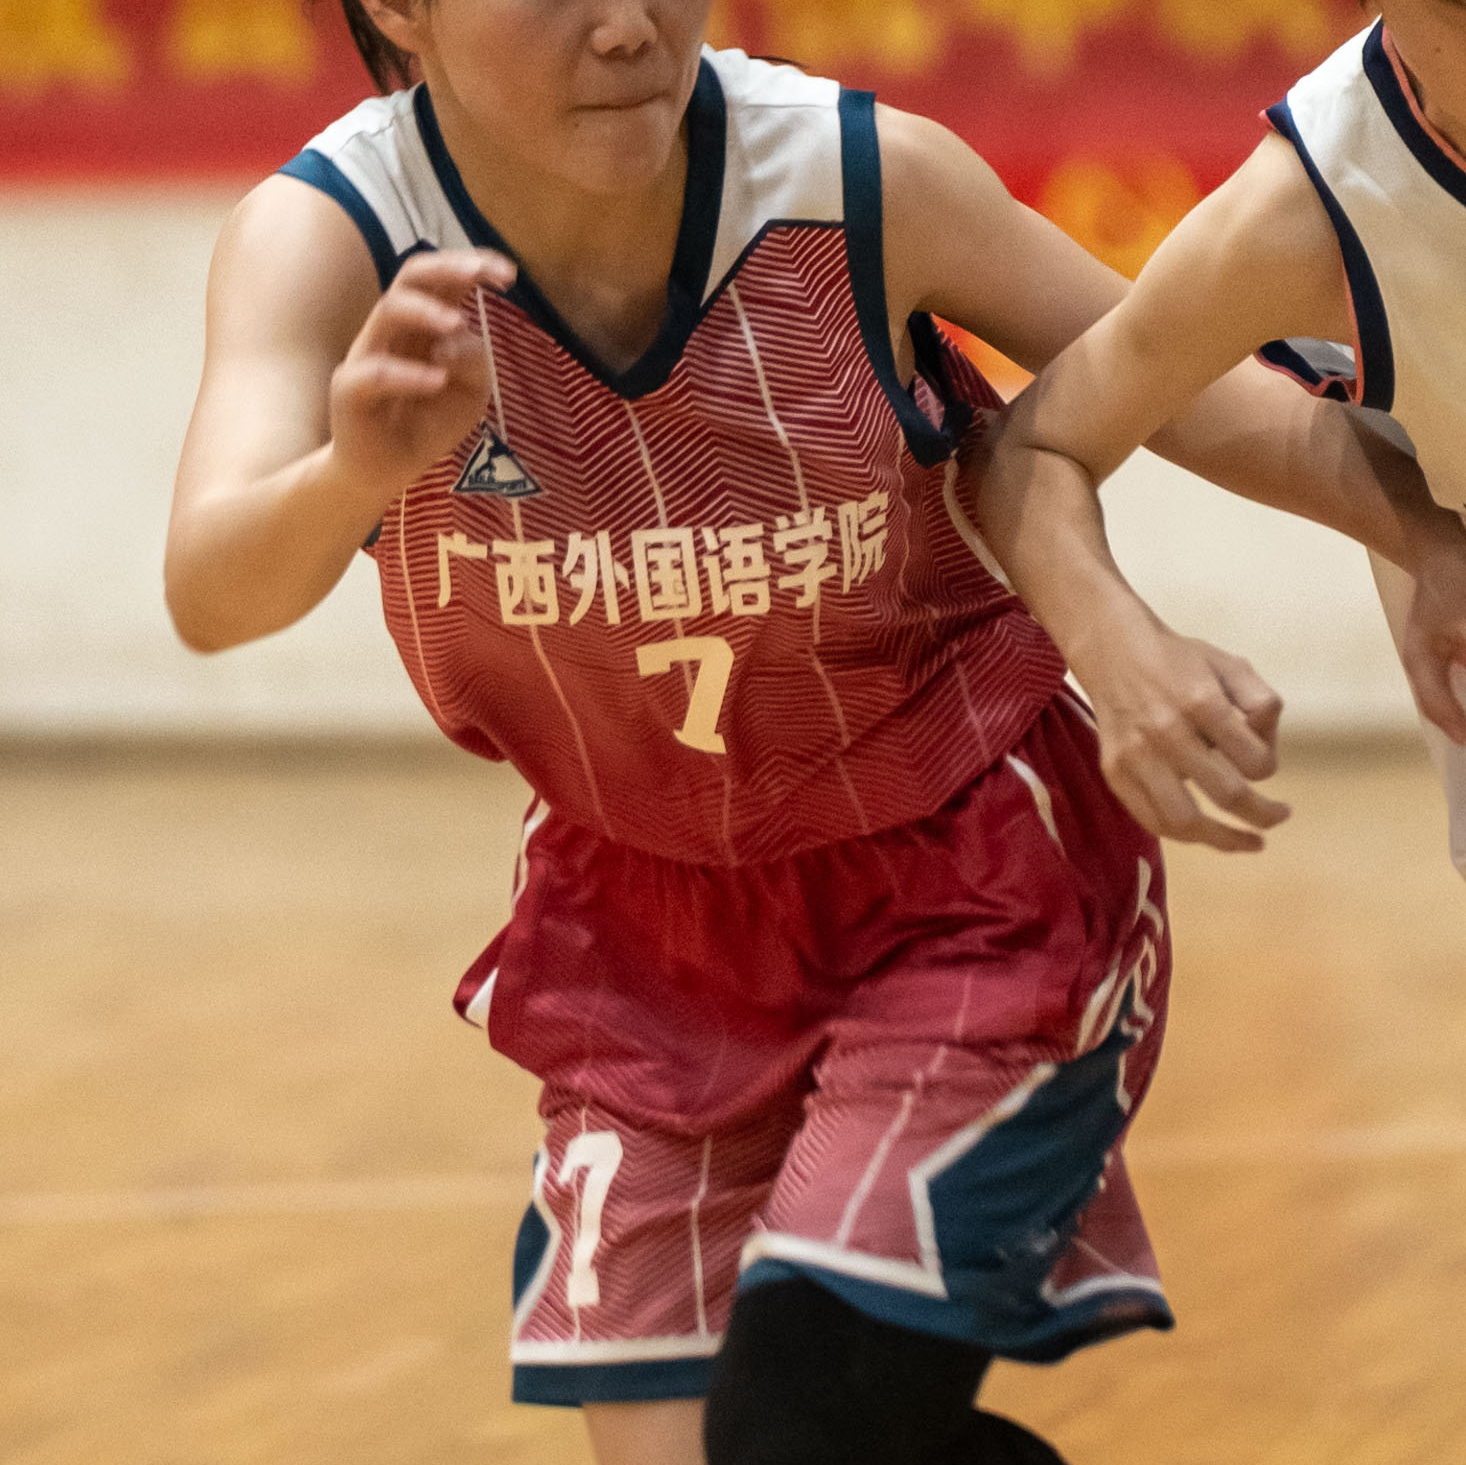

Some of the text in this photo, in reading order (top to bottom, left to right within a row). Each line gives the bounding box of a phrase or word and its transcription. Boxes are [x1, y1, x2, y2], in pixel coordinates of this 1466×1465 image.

[437, 491, 890, 627] 广西外国语学院
[635, 635, 735, 755] 7
[558, 1130, 624, 1307] 7
